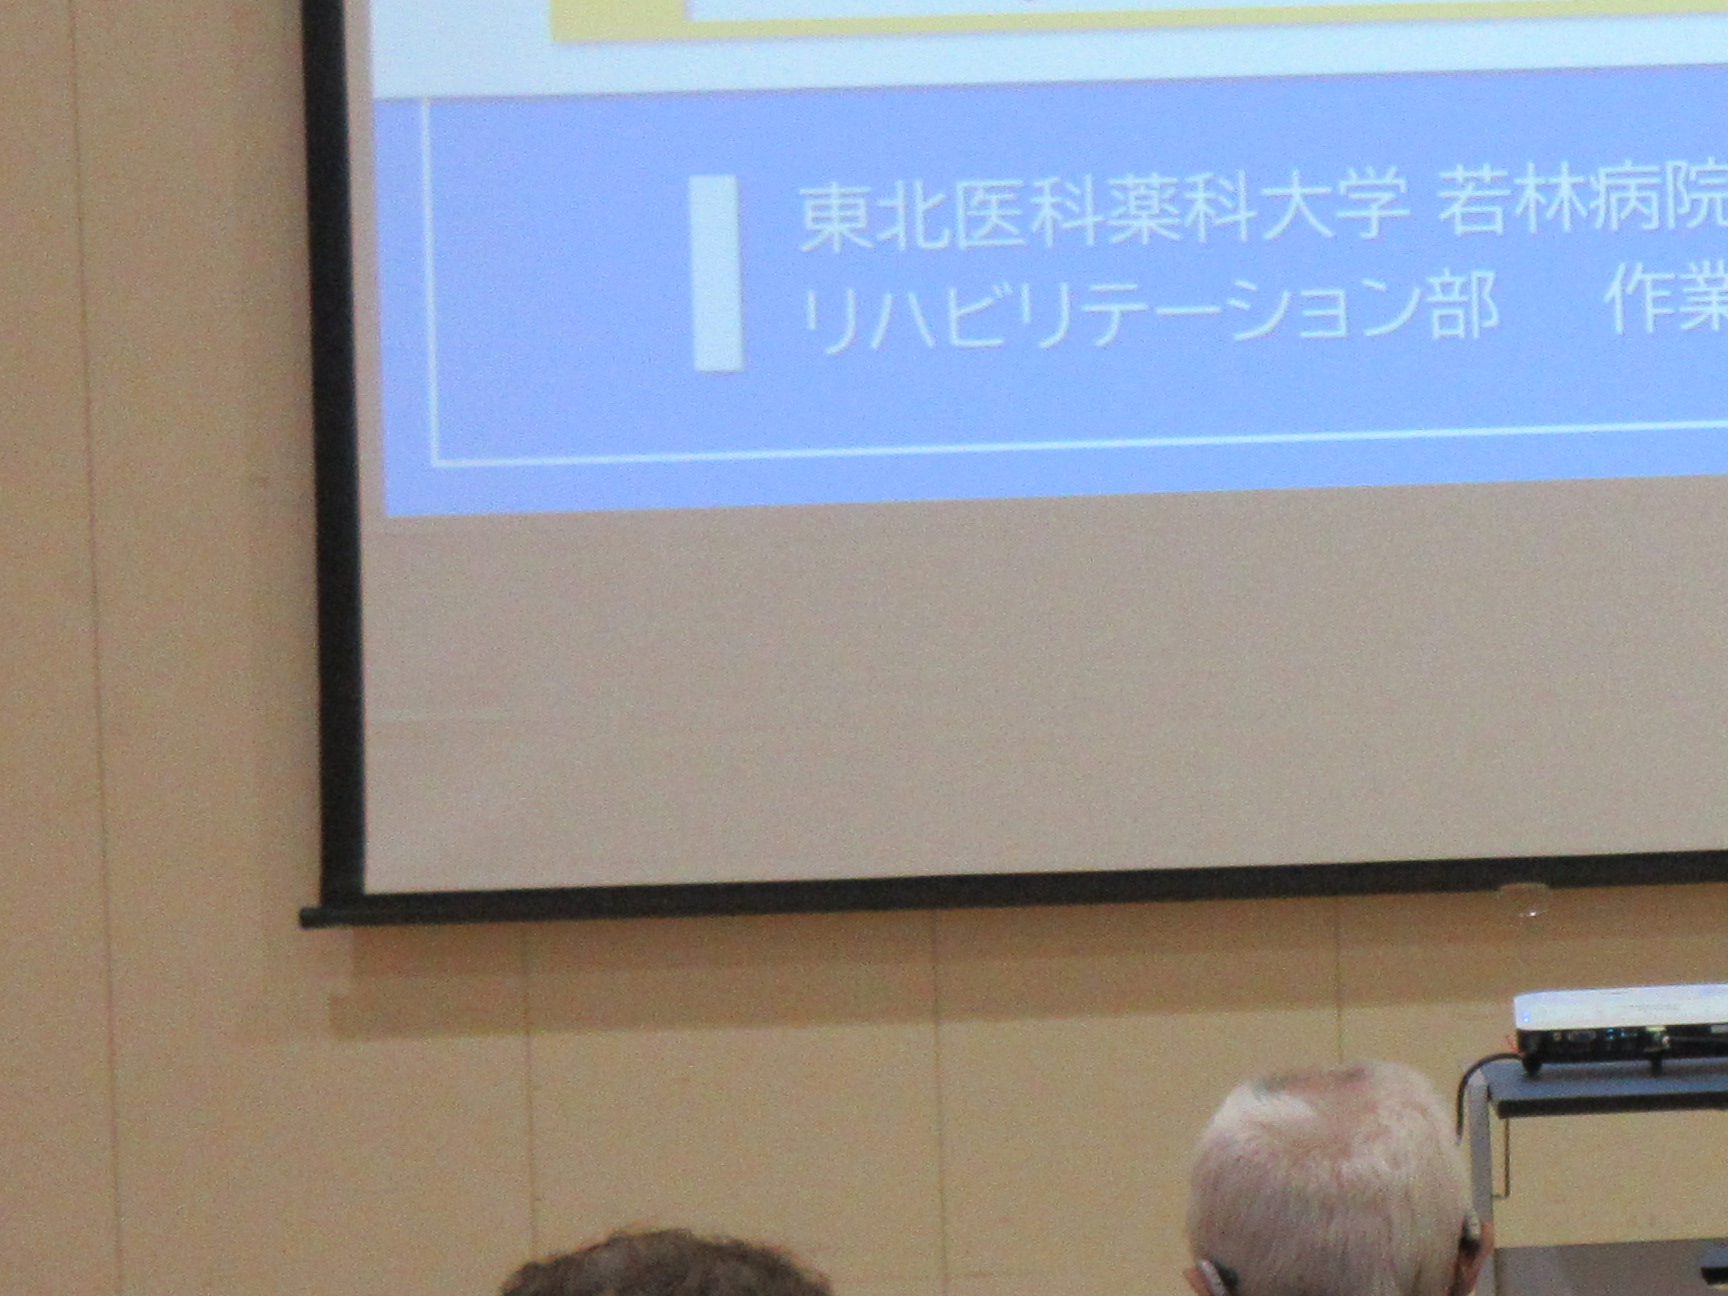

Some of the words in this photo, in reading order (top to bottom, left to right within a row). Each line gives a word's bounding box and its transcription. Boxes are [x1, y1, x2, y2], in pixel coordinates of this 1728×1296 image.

[799, 167, 1412, 254] 東北医科薬科大学
[806, 266, 1501, 356] リハビリテーション部
